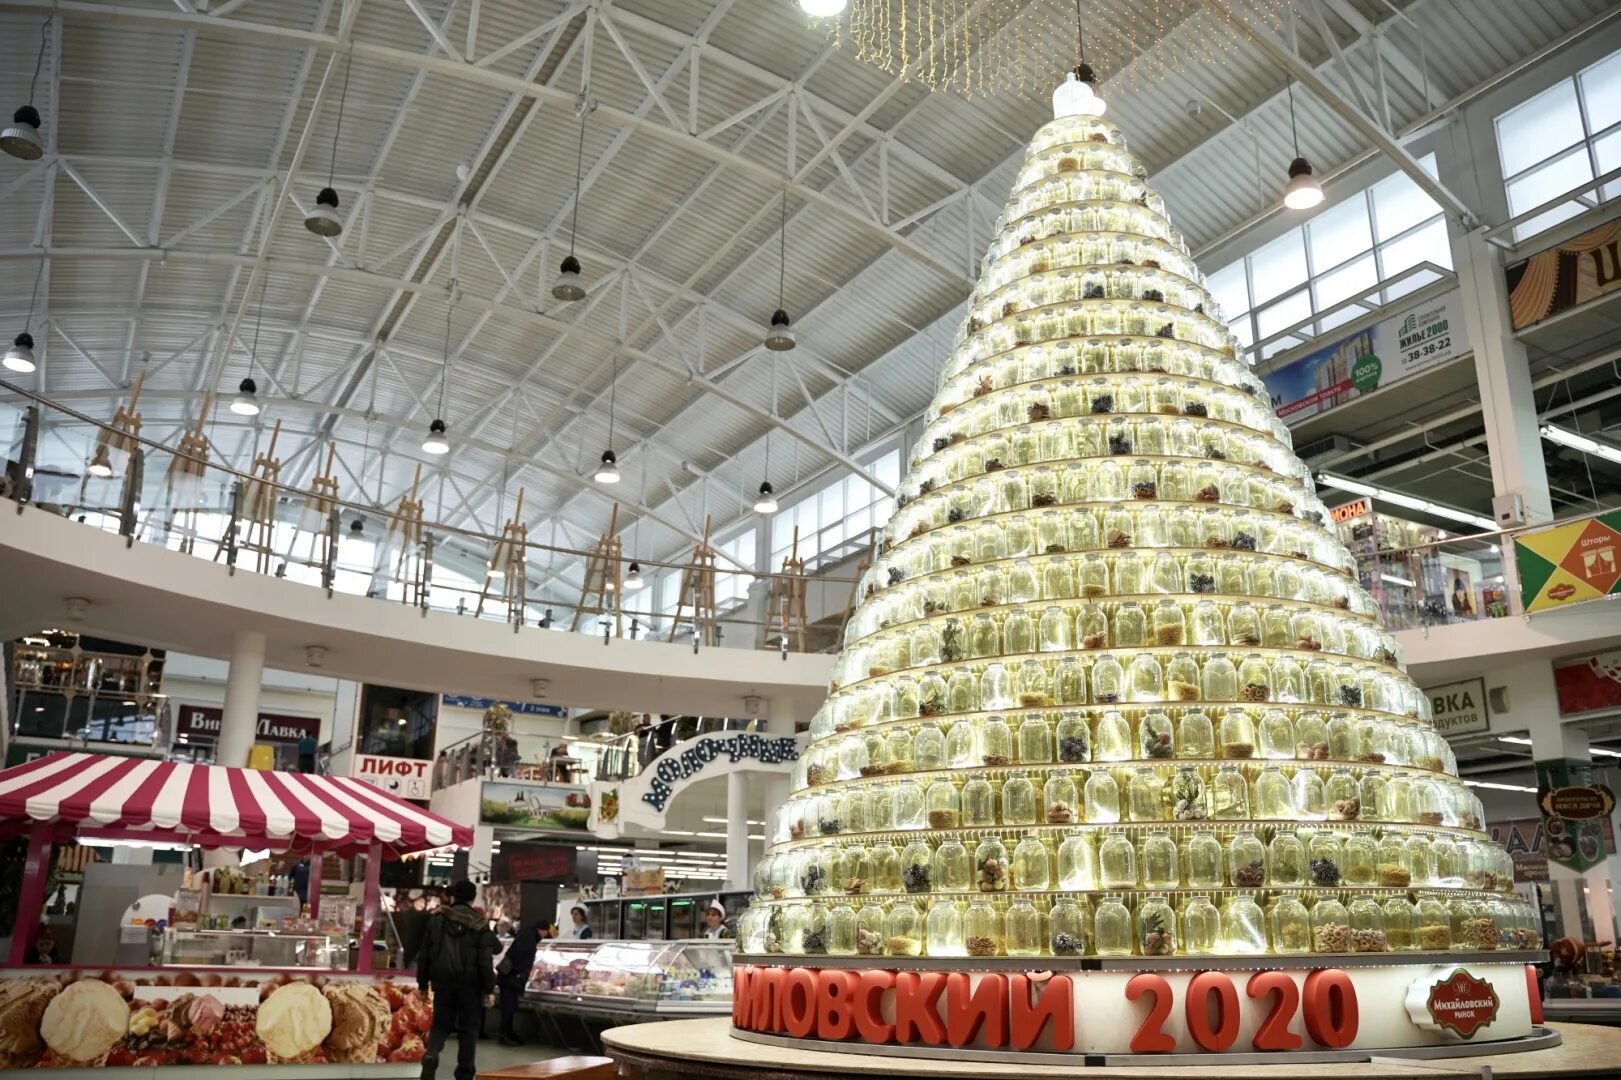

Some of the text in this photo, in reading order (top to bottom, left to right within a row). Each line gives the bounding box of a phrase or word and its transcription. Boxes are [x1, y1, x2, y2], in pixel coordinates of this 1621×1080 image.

[1400, 319, 1449, 349] ЖИЛЬЕ 2000
[1408, 337, 1451, 362] 38-38-22
[1355, 362, 1378, 377] 100%
[1581, 535, 1611, 547] Шторы
[1433, 691, 1476, 715] ВКА
[360, 758, 428, 778] ЛИФТ
[642, 734, 799, 812] МОЛОЧНЫЕ
[1125, 968, 1359, 1052] 2020
[1434, 996, 1493, 1010] Михайловский
